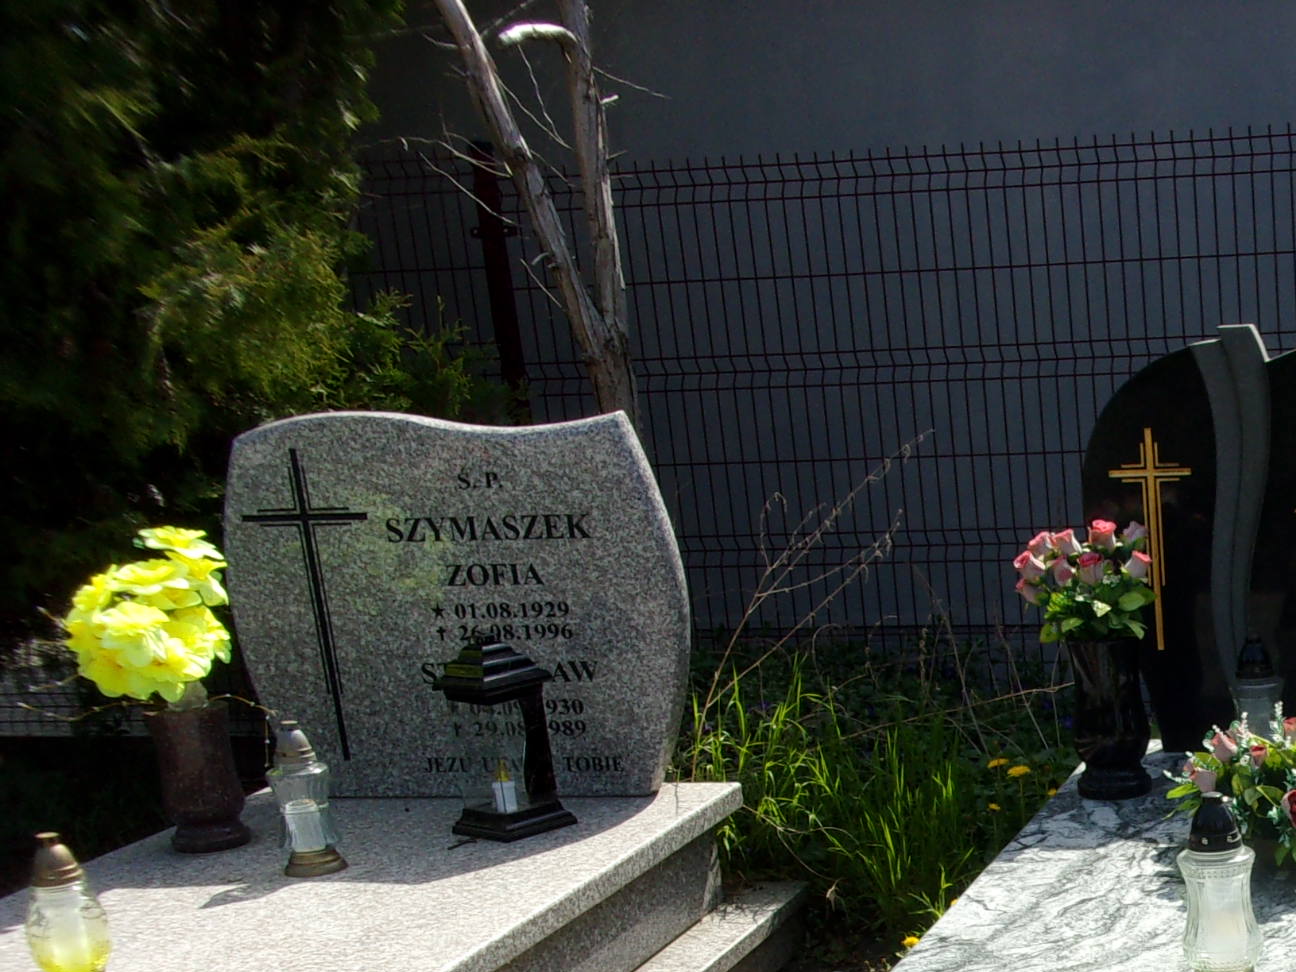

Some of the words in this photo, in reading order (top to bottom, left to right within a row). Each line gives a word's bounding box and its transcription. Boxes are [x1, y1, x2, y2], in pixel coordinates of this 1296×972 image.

[485, 471, 503, 489] P.
[385, 512, 593, 543] SZYMASZEK
[446, 562, 545, 587] ZOFIA
[454, 601, 570, 619] 01.08.1929
[458, 623, 574, 640] 2608.1996
[425, 757, 470, 773] JEZU
[562, 756, 625, 773] TOBIE
